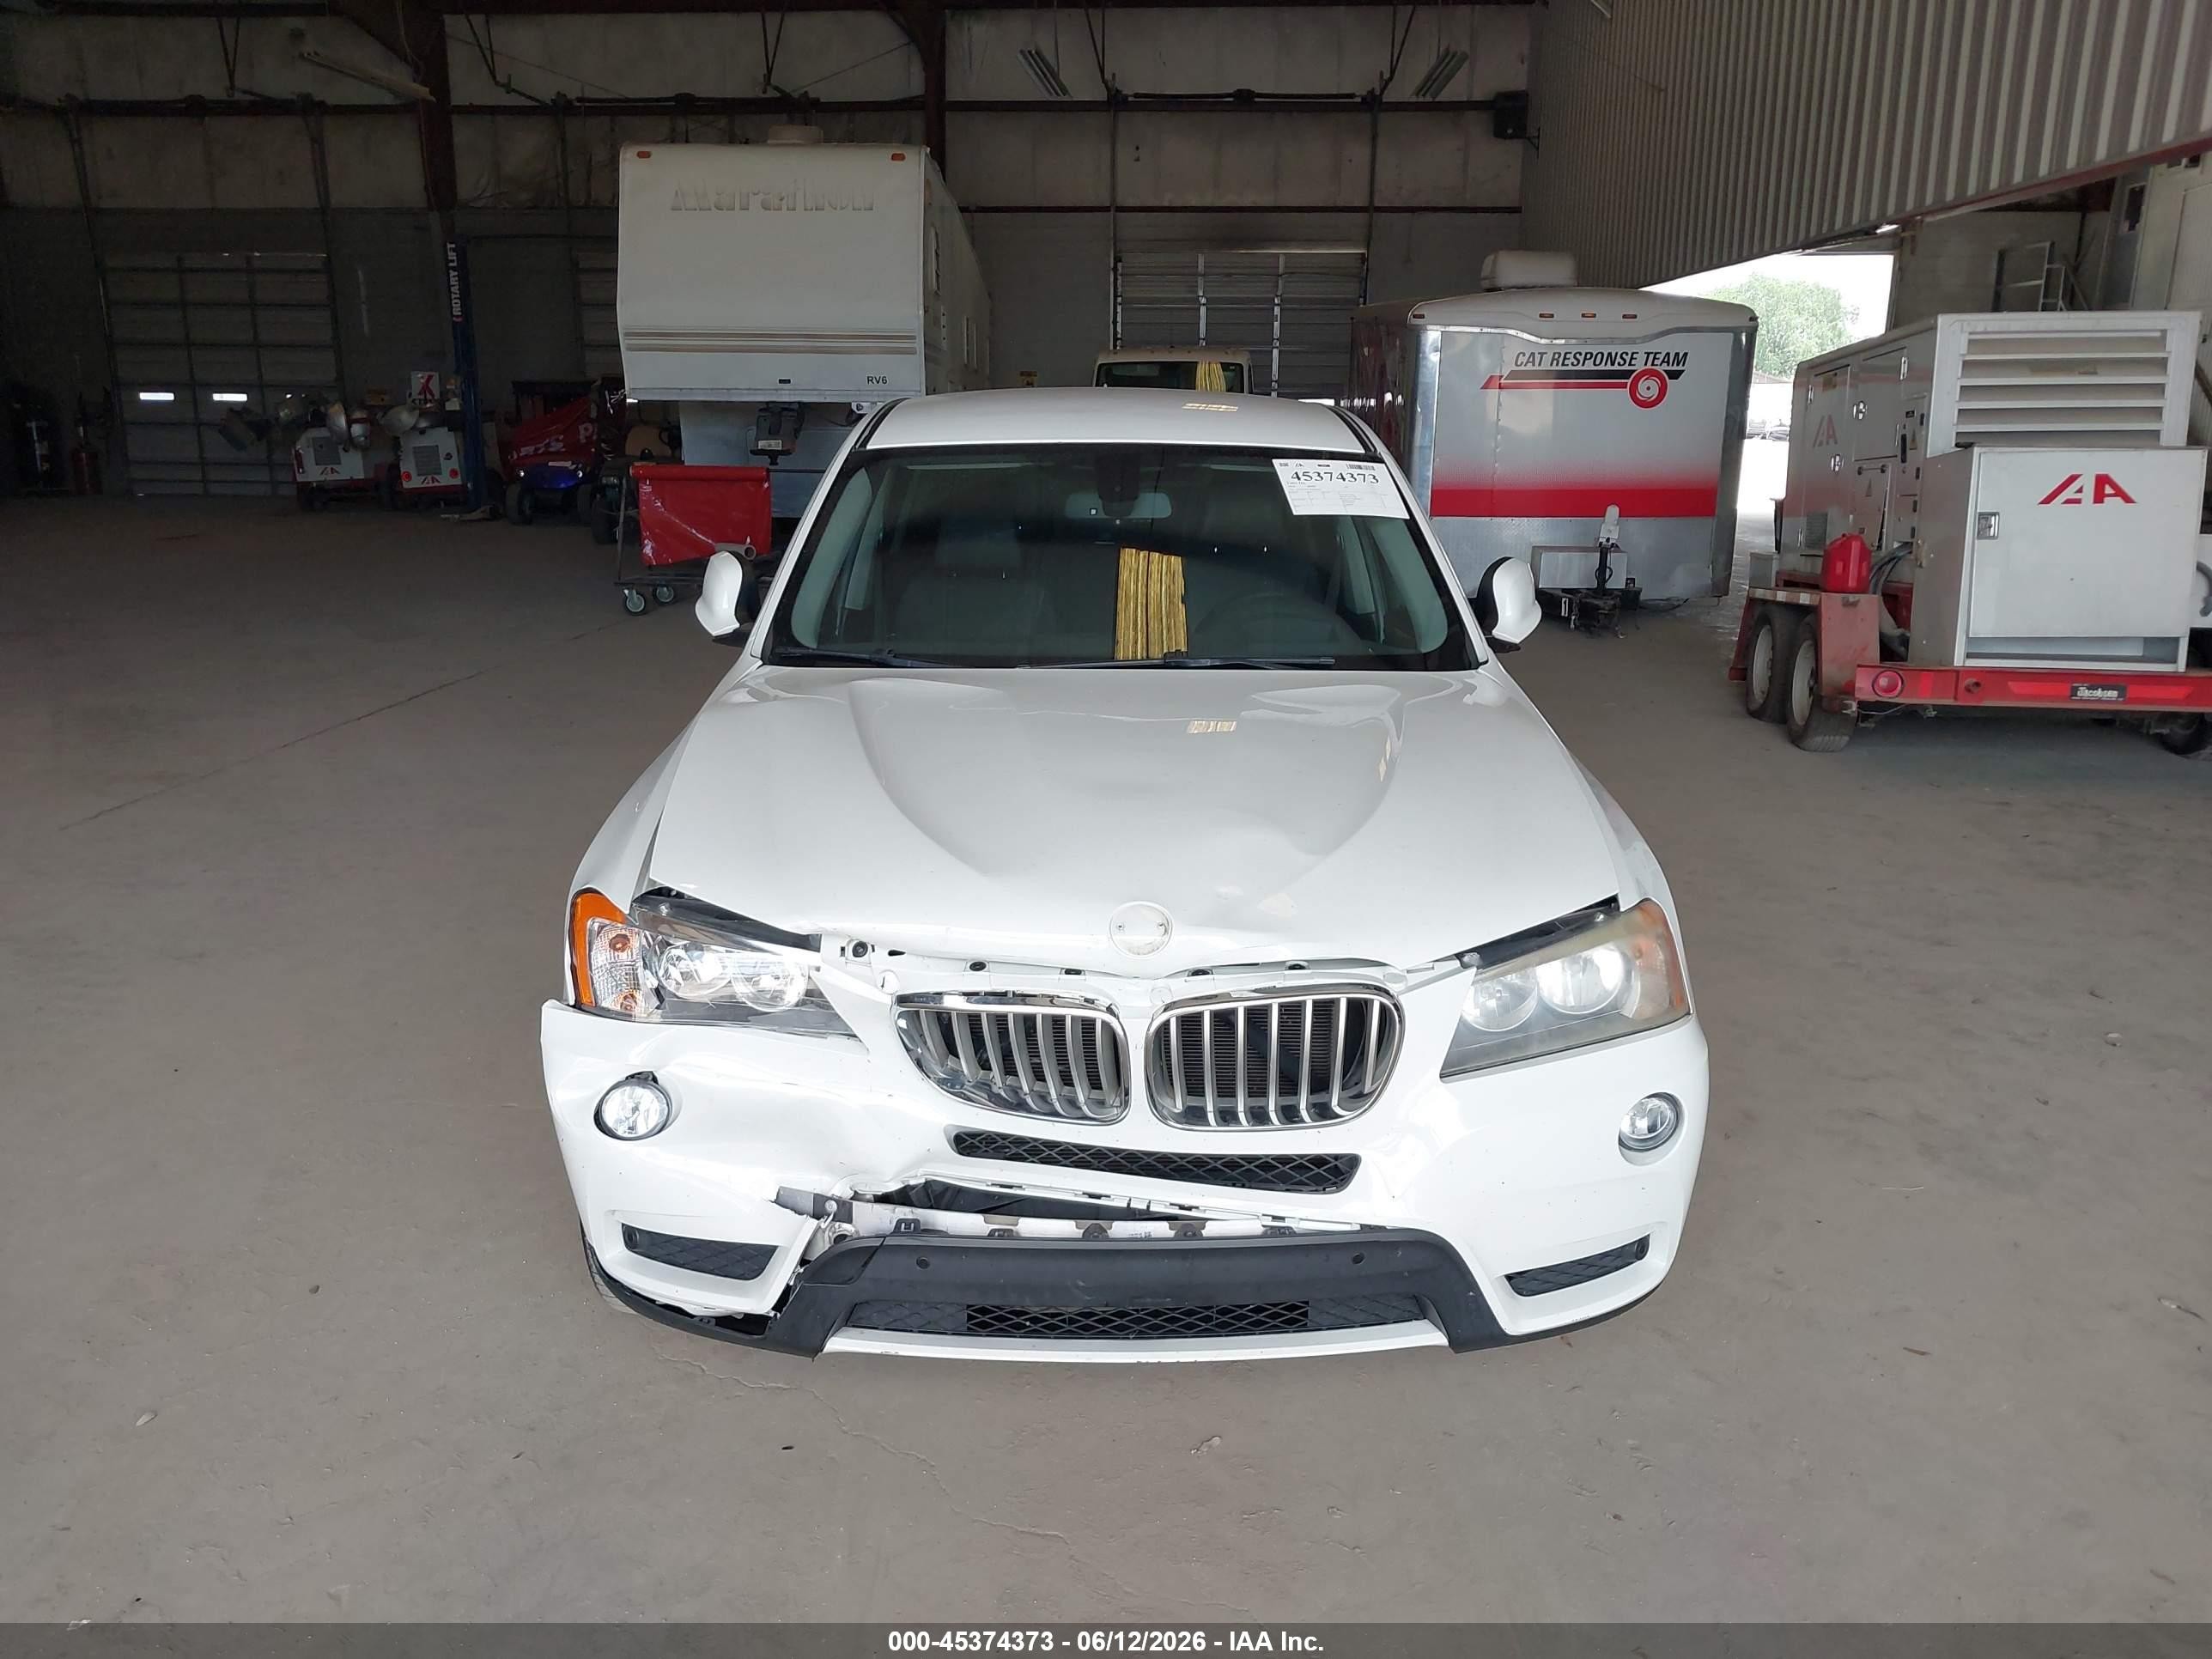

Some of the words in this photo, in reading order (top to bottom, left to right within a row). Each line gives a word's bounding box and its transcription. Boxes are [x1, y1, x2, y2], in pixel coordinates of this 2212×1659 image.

[446, 241, 458, 267] LIFT
[448, 269, 462, 316] ROTARY
[1514, 351, 1547, 367] CAT
[1550, 351, 1638, 368] RESPONSE
[1644, 351, 1689, 368] TEAM
[866, 375, 888, 385] RV6
[1291, 471, 1380, 484] 45374373
